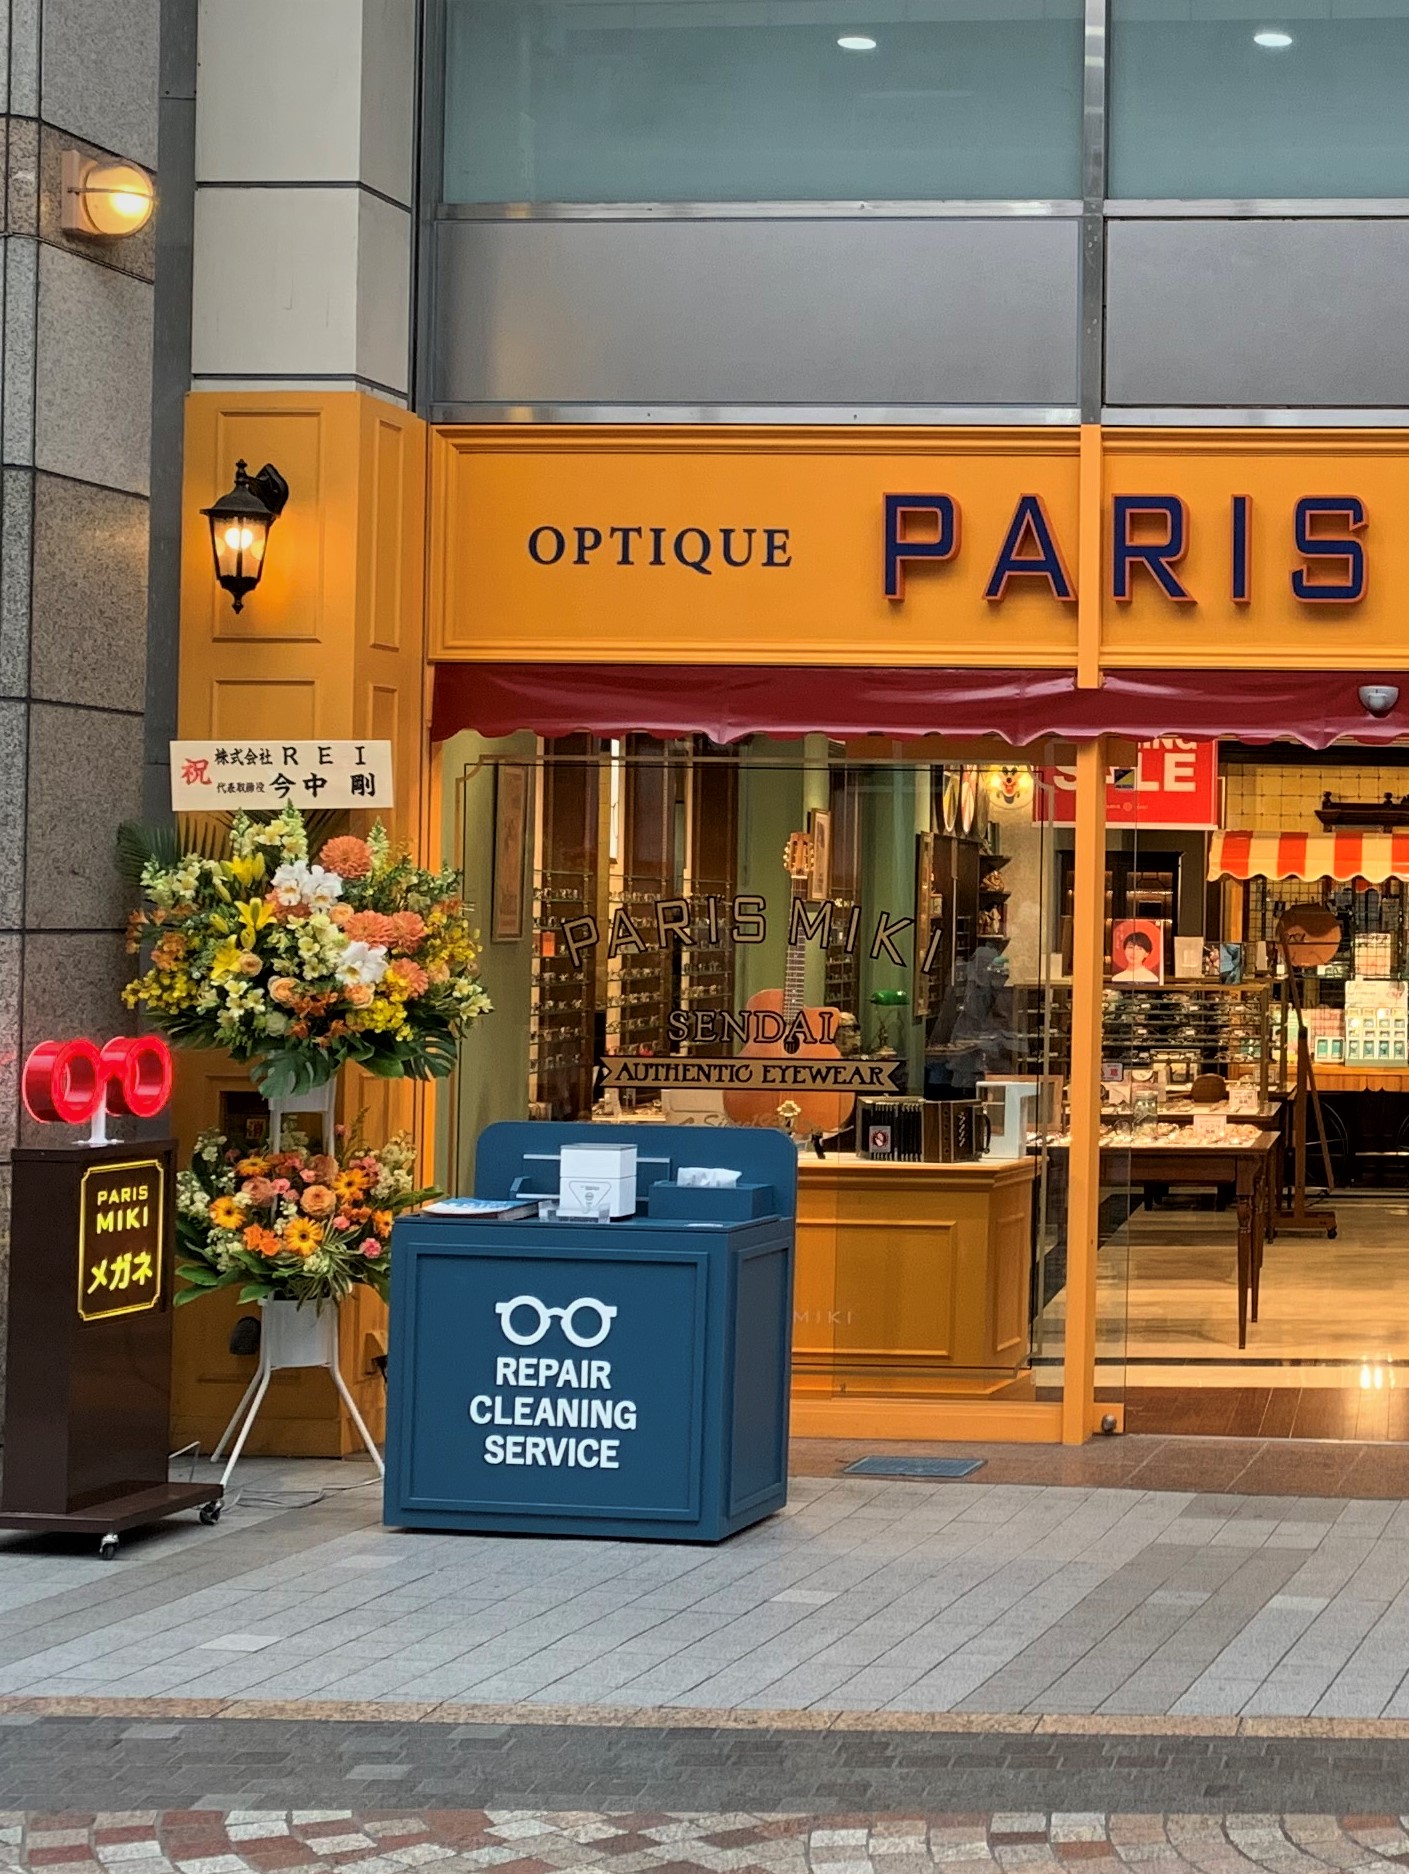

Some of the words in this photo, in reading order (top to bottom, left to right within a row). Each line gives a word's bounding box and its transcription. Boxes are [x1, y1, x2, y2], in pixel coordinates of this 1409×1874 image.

[527, 525, 794, 575] OPTIQUE
[881, 491, 1371, 606] PARIS
[181, 758, 213, 786] 祝
[214, 748, 273, 766] 株式会社
[216, 781, 266, 794] 代表取締役
[560, 894, 767, 969] PARIS
[788, 896, 943, 976] MIKI
[667, 1009, 840, 1045] SENDAI
[614, 1062, 753, 1083] AUTHENTIC
[761, 1064, 885, 1086] EYEWEAR
[97, 1185, 149, 1206] PARIS
[96, 1205, 149, 1235] MIKI
[86, 1250, 153, 1295] メガネ
[495, 1356, 611, 1390] REPAIR
[469, 1394, 637, 1431] CLEANING
[483, 1434, 620, 1469] SERVICE
